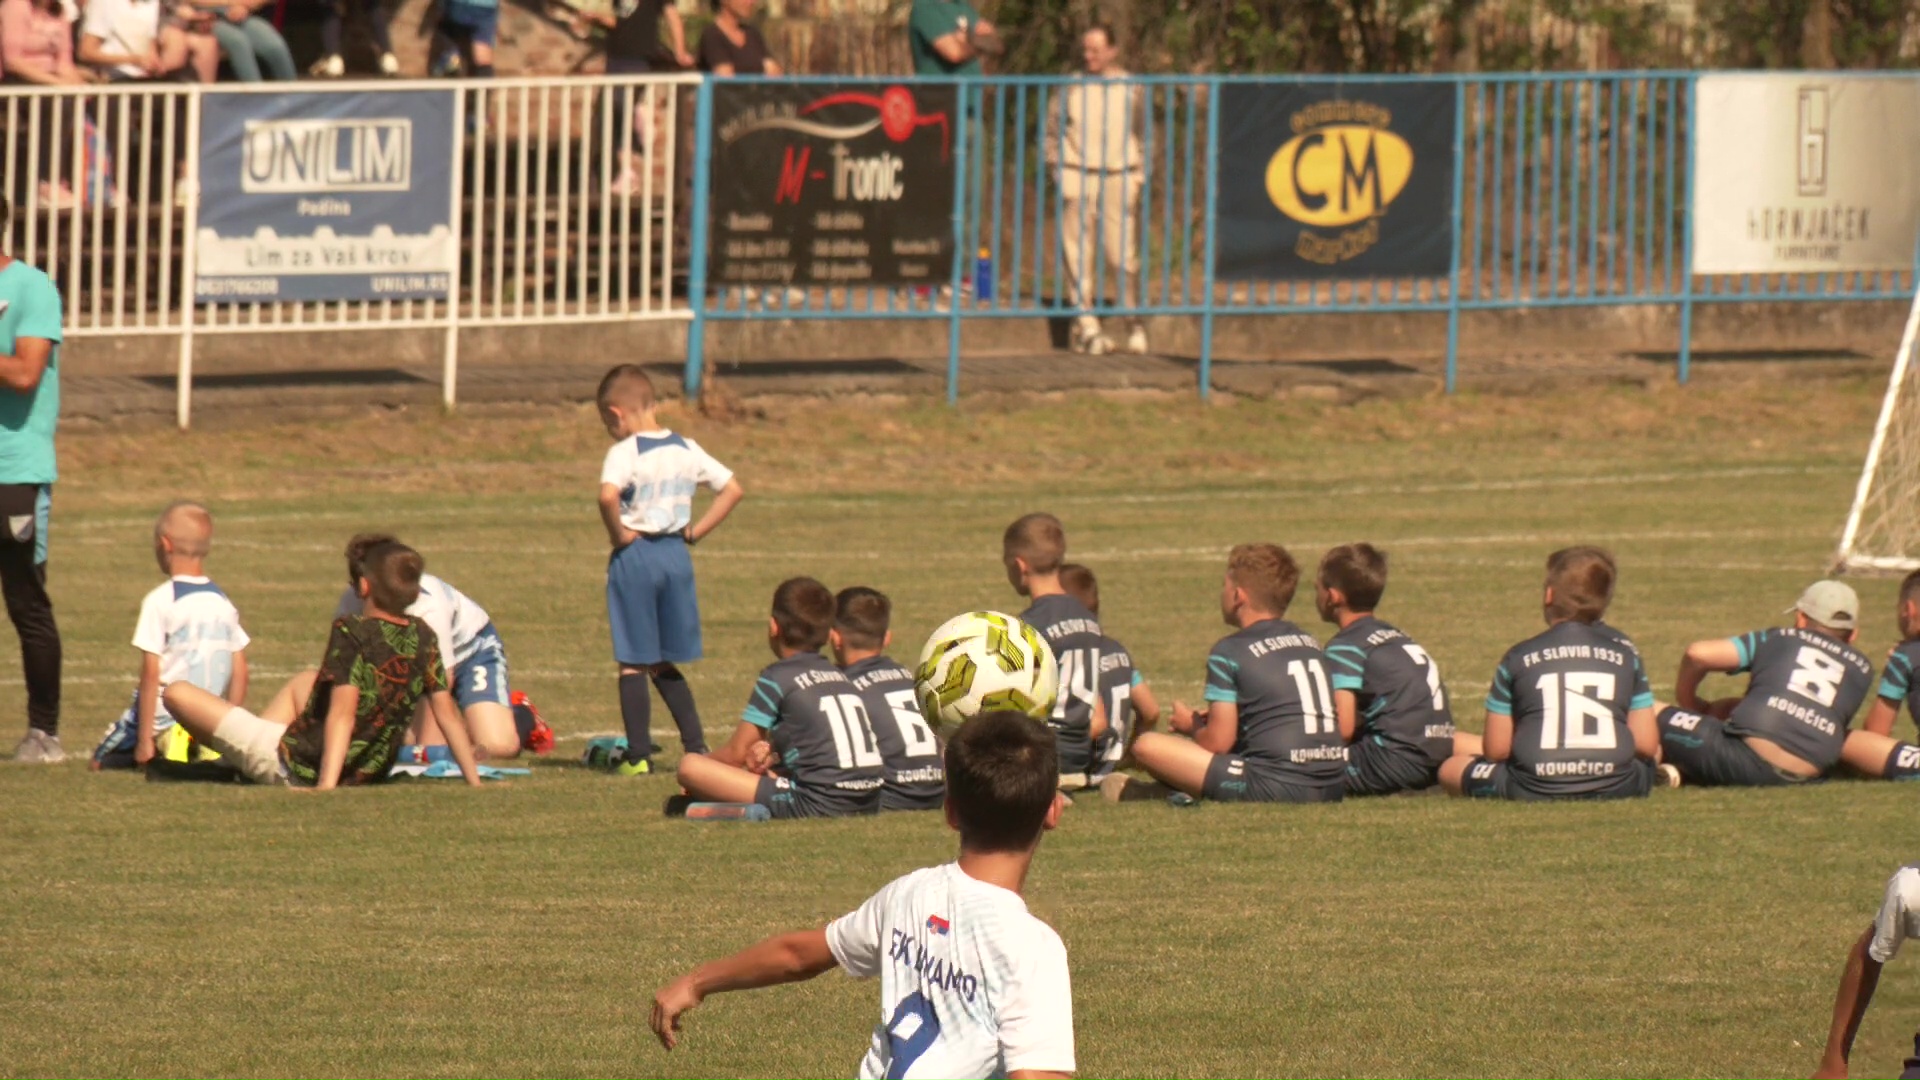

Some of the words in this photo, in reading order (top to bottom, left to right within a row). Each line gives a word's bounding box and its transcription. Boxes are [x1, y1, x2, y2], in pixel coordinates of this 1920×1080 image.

[247, 123, 405, 184] UNILIM
[248, 247, 284, 268] Lim
[290, 251, 313, 266] za
[366, 243, 412, 264] krov
[1249, 640, 1270, 658] FK
[1264, 634, 1304, 651] SLAVIA
[1523, 653, 1542, 668] FK
[1543, 645, 1591, 662] SLAVIA
[1593, 647, 1624, 666] 1933
[471, 666, 488, 692] 3
[794, 672, 814, 690] FK
[853, 675, 873, 691] FK
[1402, 644, 1444, 711] 7
[1786, 646, 1846, 708] 8
[1287, 659, 1335, 734] 11
[1535, 672, 1617, 750] 16
[819, 694, 883, 769] 10
[1767, 696, 1837, 736] KOVAČICA
[1535, 759, 1615, 777] KOVAČICA
